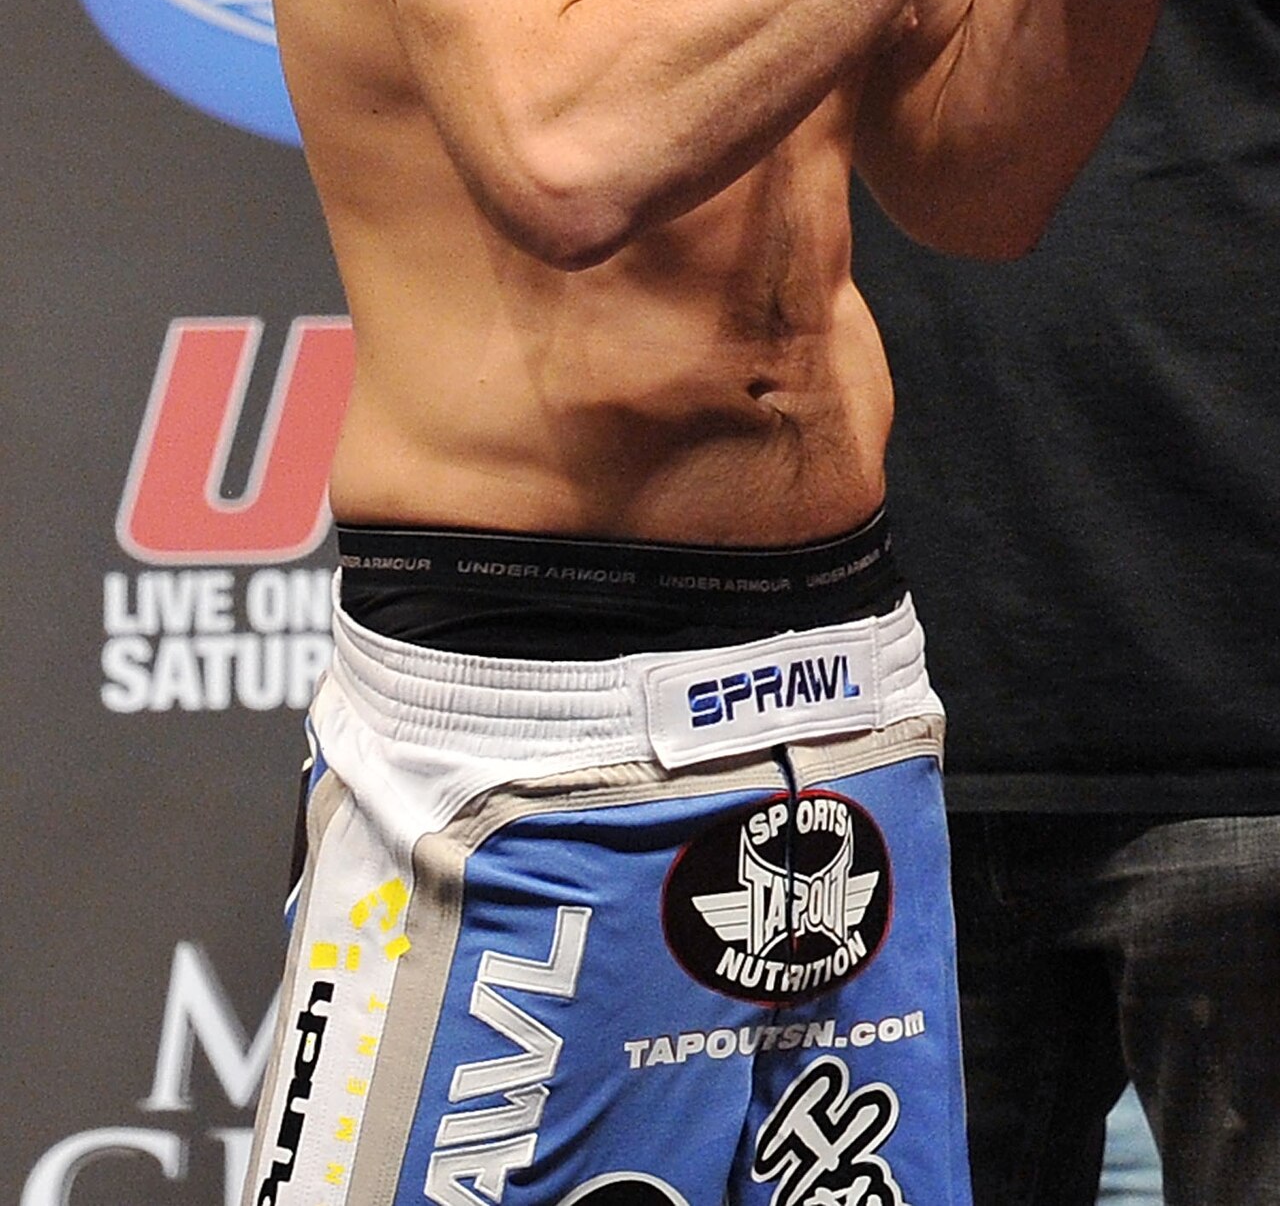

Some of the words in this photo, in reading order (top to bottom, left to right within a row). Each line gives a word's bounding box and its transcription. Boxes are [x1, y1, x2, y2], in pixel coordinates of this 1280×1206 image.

[103, 570, 236, 635] LIVE
[246, 569, 334, 634] ON
[457, 559, 540, 579] UNDER
[544, 565, 637, 584] ARMOUR
[687, 654, 861, 730] SPRAWL
[748, 799, 848, 845] SPORTS
[715, 930, 868, 993] NUTRITION
[623, 1010, 926, 1070] TAPOUTSN.com
